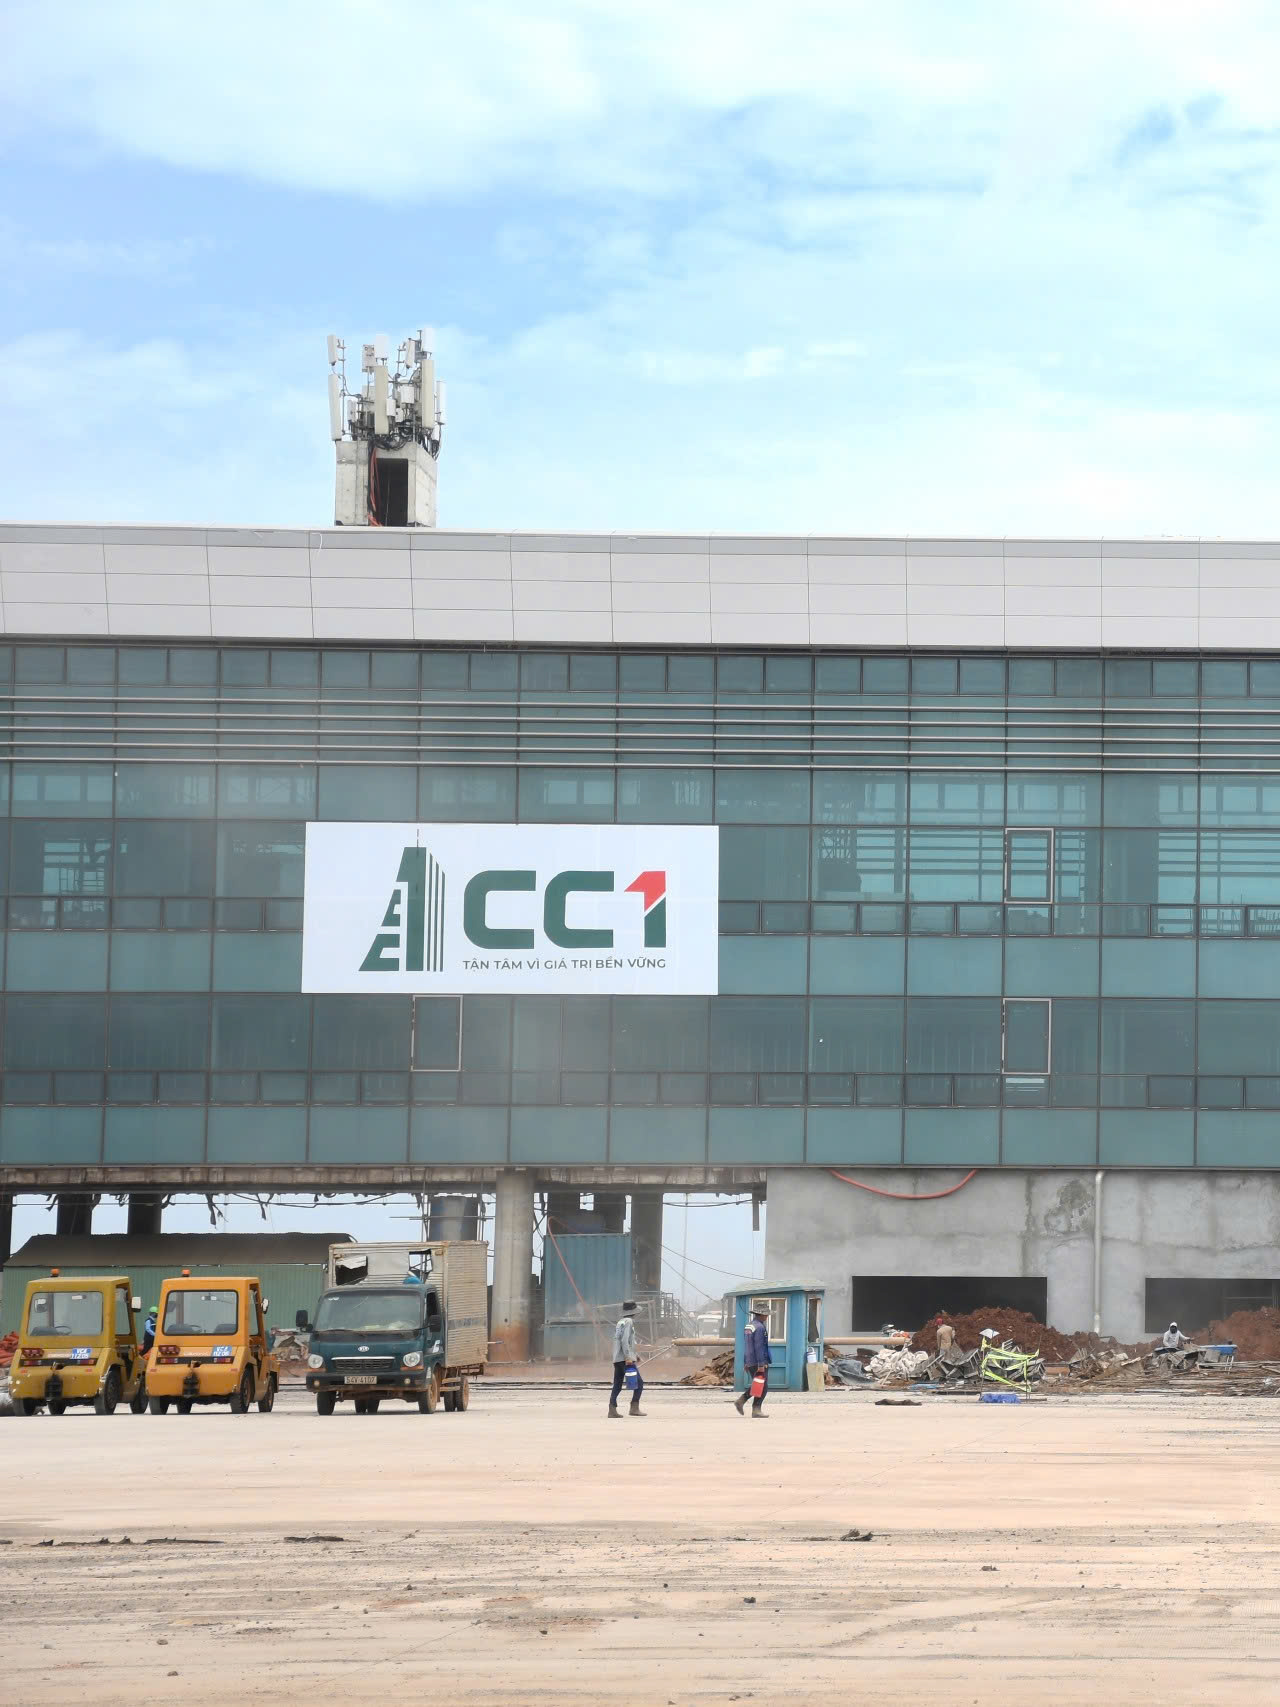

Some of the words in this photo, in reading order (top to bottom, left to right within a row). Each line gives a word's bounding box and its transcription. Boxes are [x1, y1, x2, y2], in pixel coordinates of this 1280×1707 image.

[463, 870, 667, 950] CC1
[462, 957, 490, 971] TẬN
[494, 957, 522, 969] TÂM
[526, 957, 540, 969] VÌ
[543, 957, 568, 969] GIÁ
[570, 959, 592, 971] TRỊ
[595, 955, 623, 969] BỀN
[627, 956, 666, 969] VỮNG
